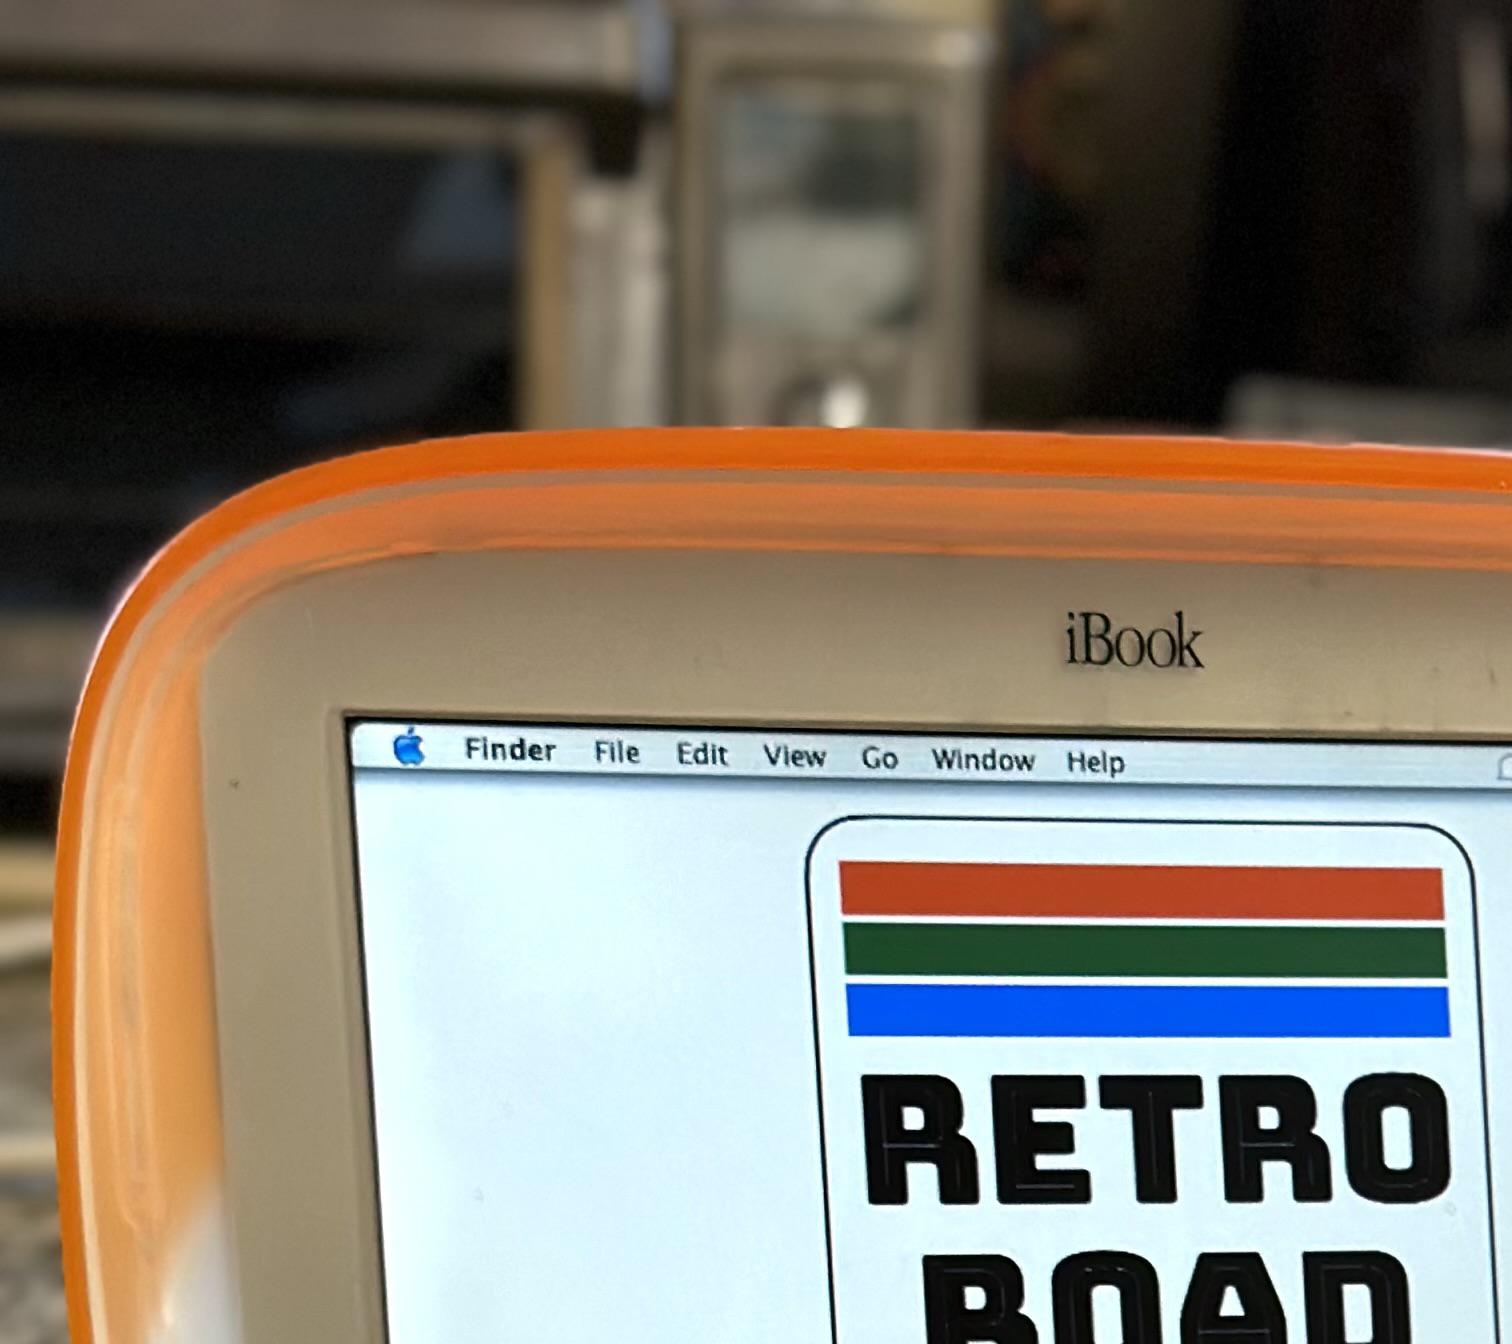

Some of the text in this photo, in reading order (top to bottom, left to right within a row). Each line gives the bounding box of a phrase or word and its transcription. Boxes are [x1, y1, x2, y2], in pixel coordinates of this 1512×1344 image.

[1065, 610, 1205, 668] iBook
[465, 737, 1126, 778] Finder File Edit View Go Window Help
[861, 1072, 1452, 1205] RETRO
